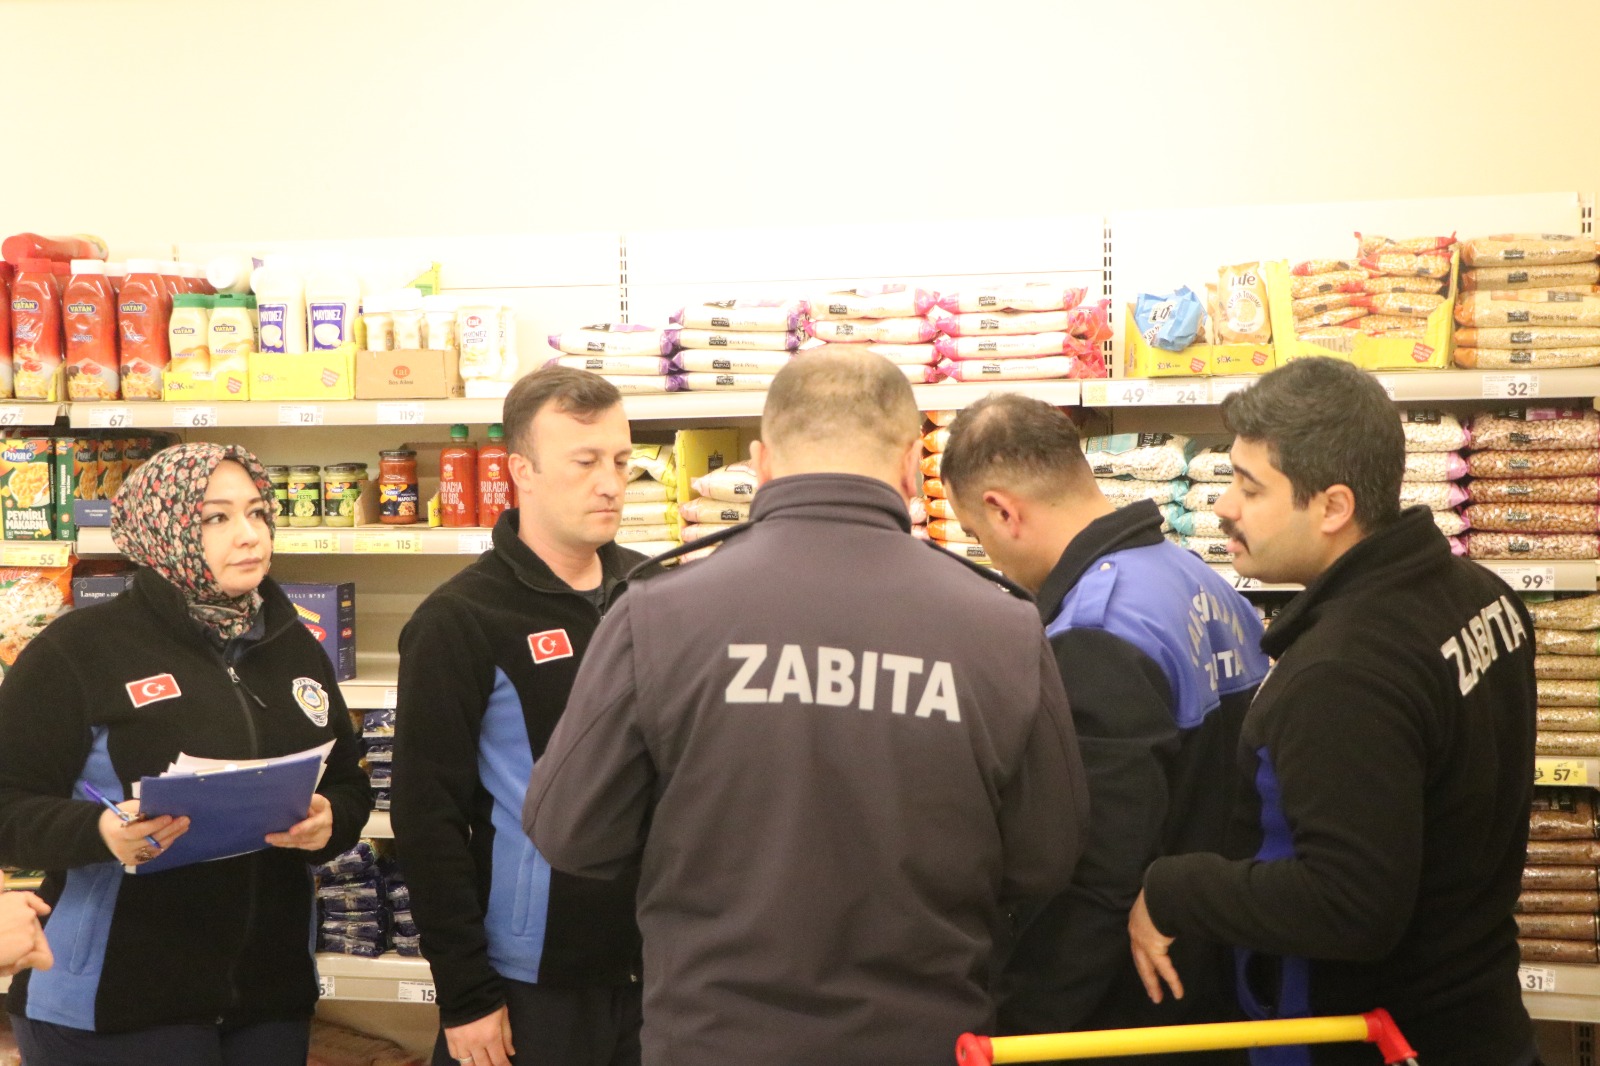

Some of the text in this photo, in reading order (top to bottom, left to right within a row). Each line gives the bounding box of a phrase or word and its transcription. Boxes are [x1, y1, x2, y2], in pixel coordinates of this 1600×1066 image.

[14, 302, 35, 310] VATAN
[70, 305, 93, 313] VATAN
[122, 304, 144, 312] VATAN
[261, 310, 283, 322] MAYONEZ
[313, 309, 341, 321] MAYONEZ
[1507, 382, 1528, 396] 32
[1122, 388, 1145, 403] 49
[1177, 390, 1197, 404] 24
[0, 413, 16, 424] 67
[109, 414, 125, 426] 67
[192, 414, 208, 426] 65
[299, 412, 314, 423] 121
[399, 410, 415, 421] 119
[4, 450, 32, 461] Piyale
[481, 481, 509, 493] SRIRACHA
[448, 492, 460, 504] SOS
[494, 492, 506, 505] SOS
[7, 508, 46, 521] PEYNİRLİ
[6, 519, 48, 531] MAKARNA
[314, 539, 329, 549] 115
[396, 540, 411, 550] 115
[480, 541, 495, 551] 115
[39, 554, 54, 565] 55
[1233, 575, 1252, 588] 72
[1522, 575, 1543, 589] 99
[80, 590, 105, 600] Lasagne
[1440, 595, 1528, 696] ZABITA
[725, 643, 961, 723] ZABITA
[1553, 768, 1571, 781] 57
[1526, 974, 1543, 990] 31
[319, 984, 326, 996] 5
[421, 989, 435, 1002] 15
